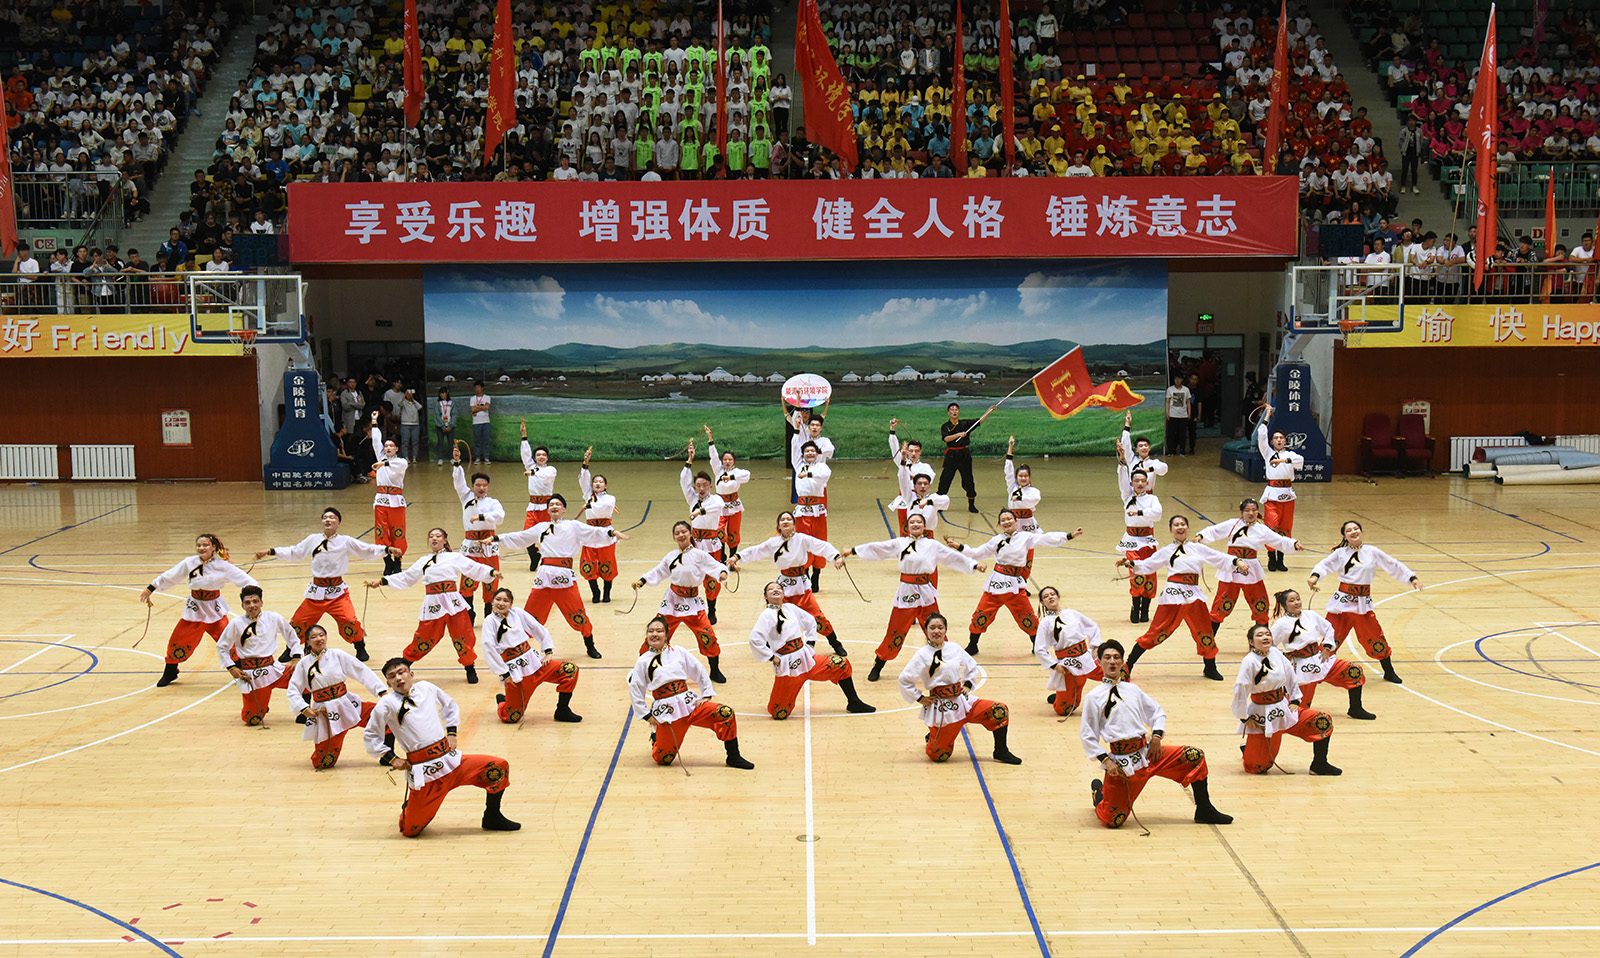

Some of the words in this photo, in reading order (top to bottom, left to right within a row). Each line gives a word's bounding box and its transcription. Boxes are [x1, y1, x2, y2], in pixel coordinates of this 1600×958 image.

[344, 200, 538, 243] 享受乐趣
[579, 198, 771, 241] 增强体质
[812, 196, 1005, 240] 健全人格
[1046, 194, 1238, 238] 锤炼意志
[34, 239, 55, 249] C区
[2, 318, 41, 352] 好
[51, 324, 189, 354] Friendly
[292, 375, 307, 419] 金陵体育
[1288, 369, 1301, 412] 金陵体育
